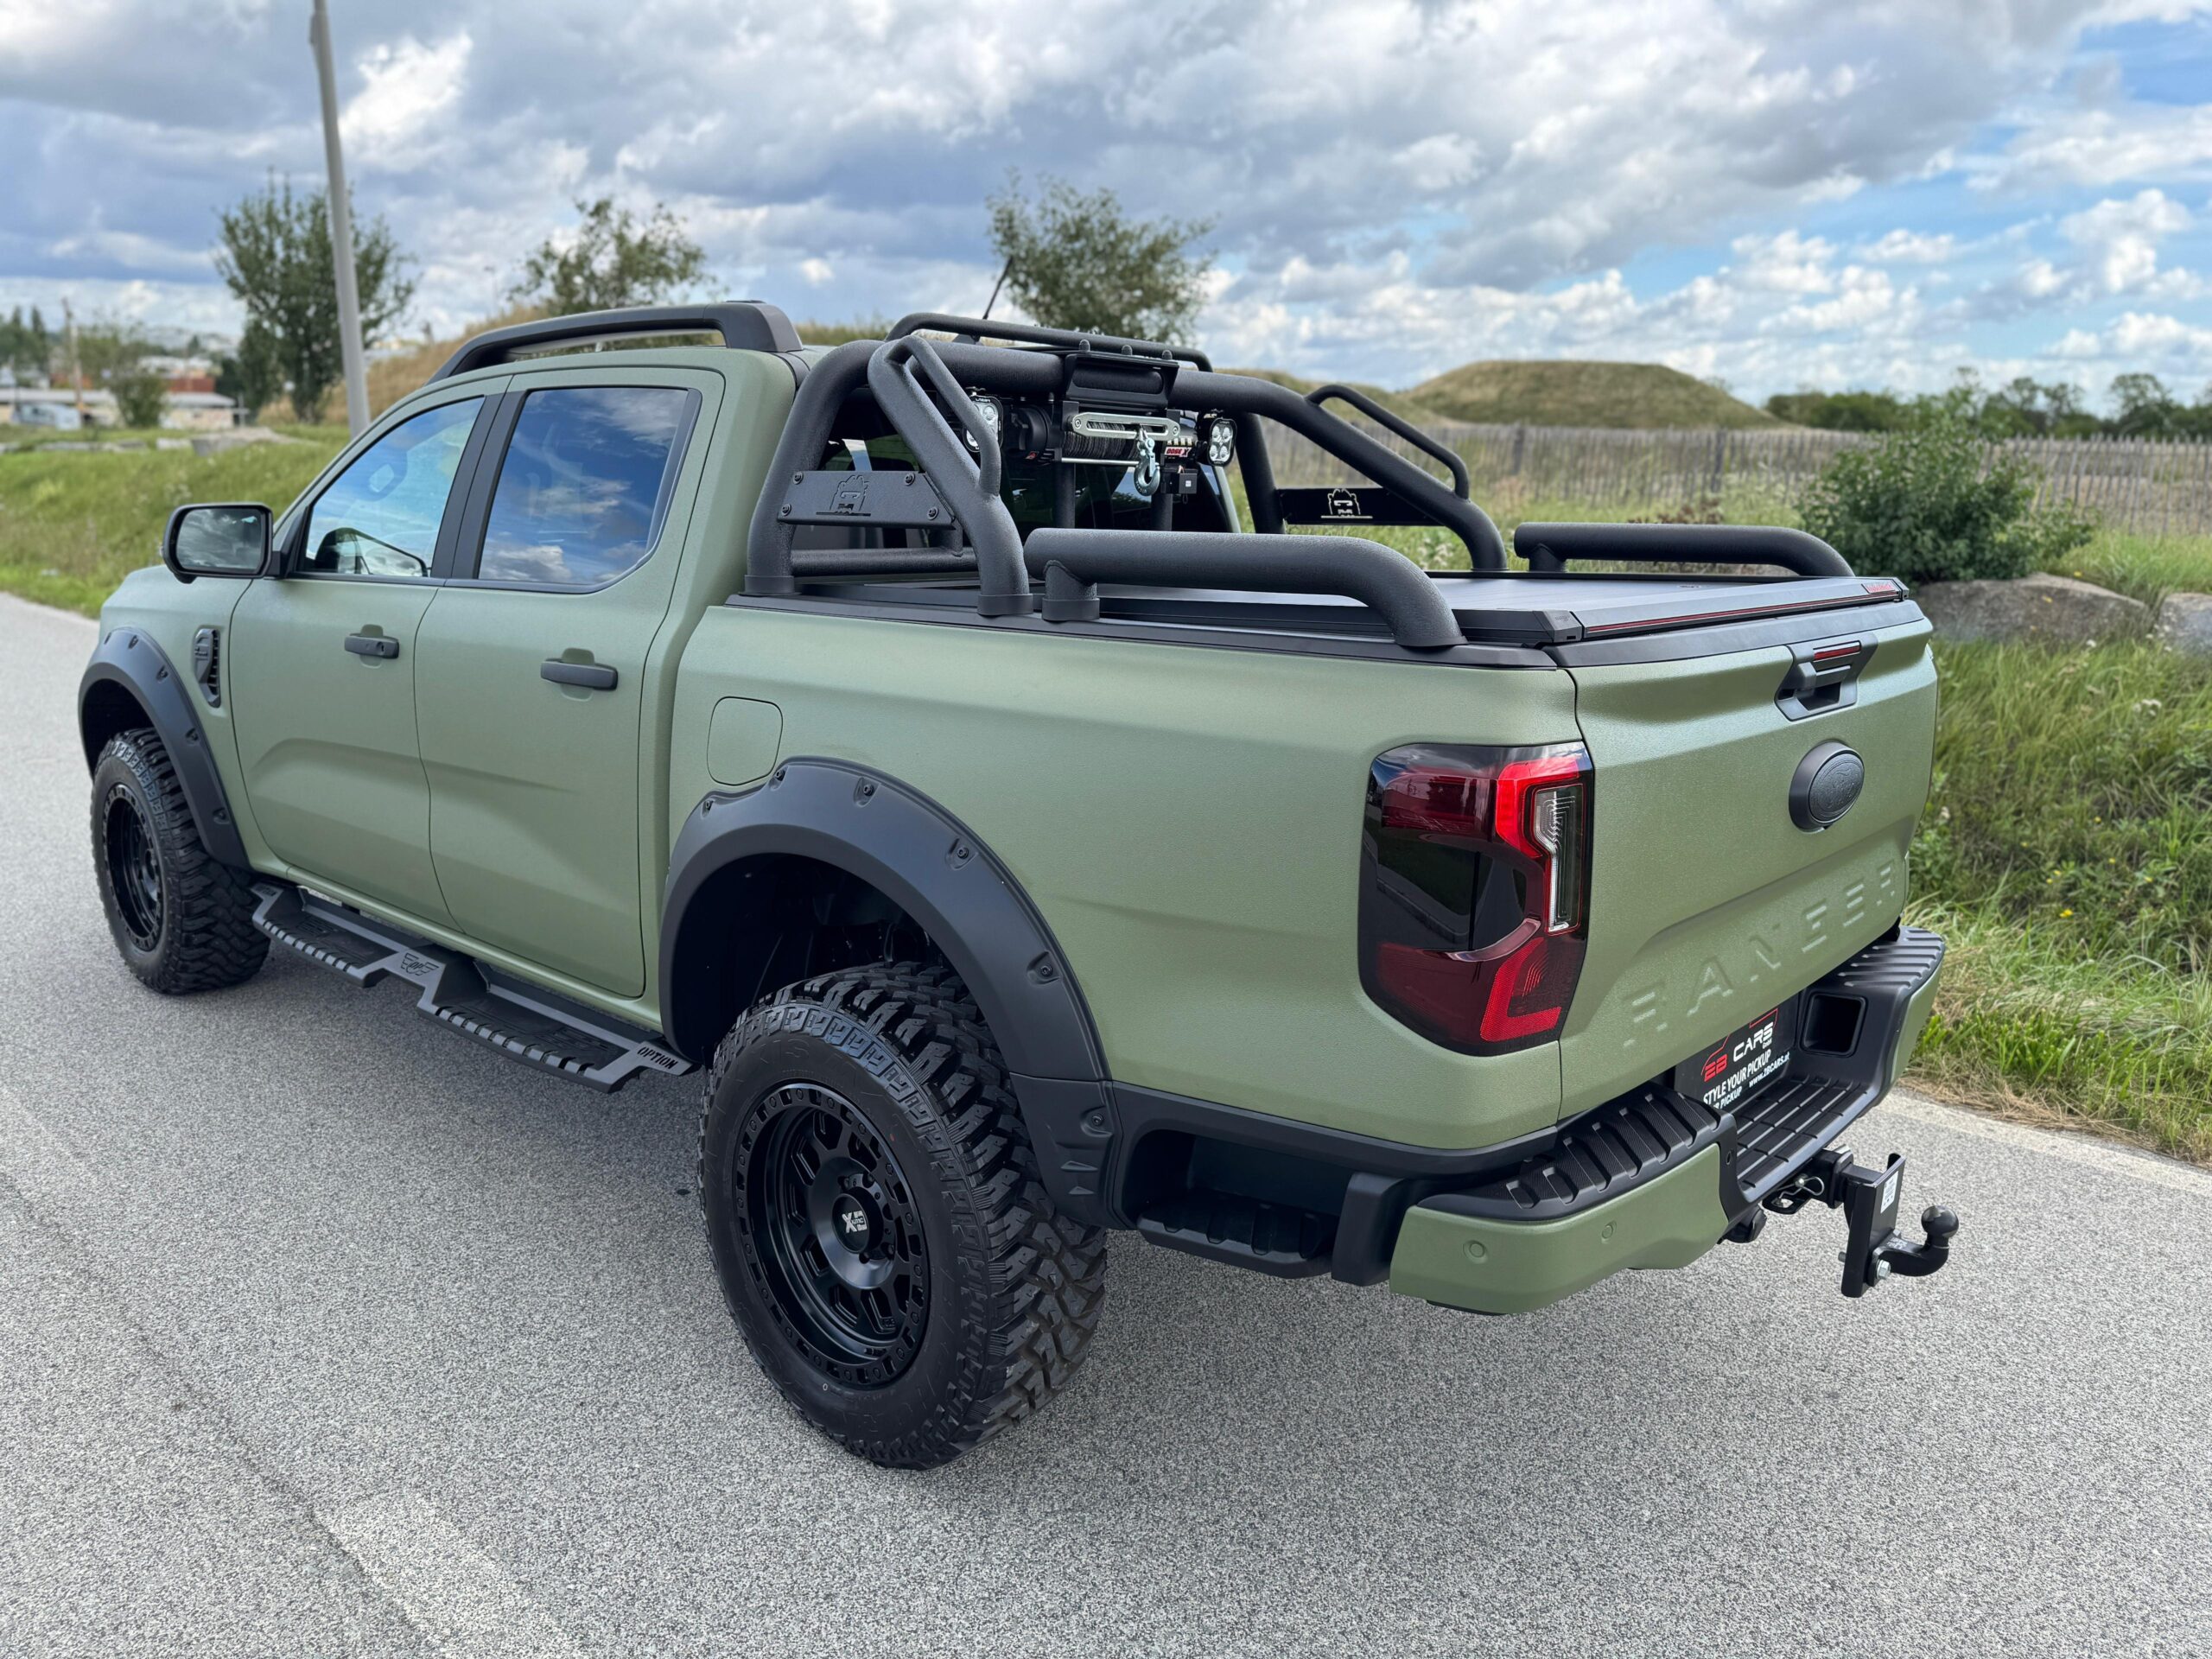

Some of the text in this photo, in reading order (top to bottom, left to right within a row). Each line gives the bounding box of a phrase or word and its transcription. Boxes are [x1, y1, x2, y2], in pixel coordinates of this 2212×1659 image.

[1733, 1021, 1773, 1062] CARS
[637, 1046, 678, 1070] OPTION
[1703, 1048, 1771, 1105] STYLE YOUR PICKUP
[1719, 1085, 1743, 1109] PICKUP
